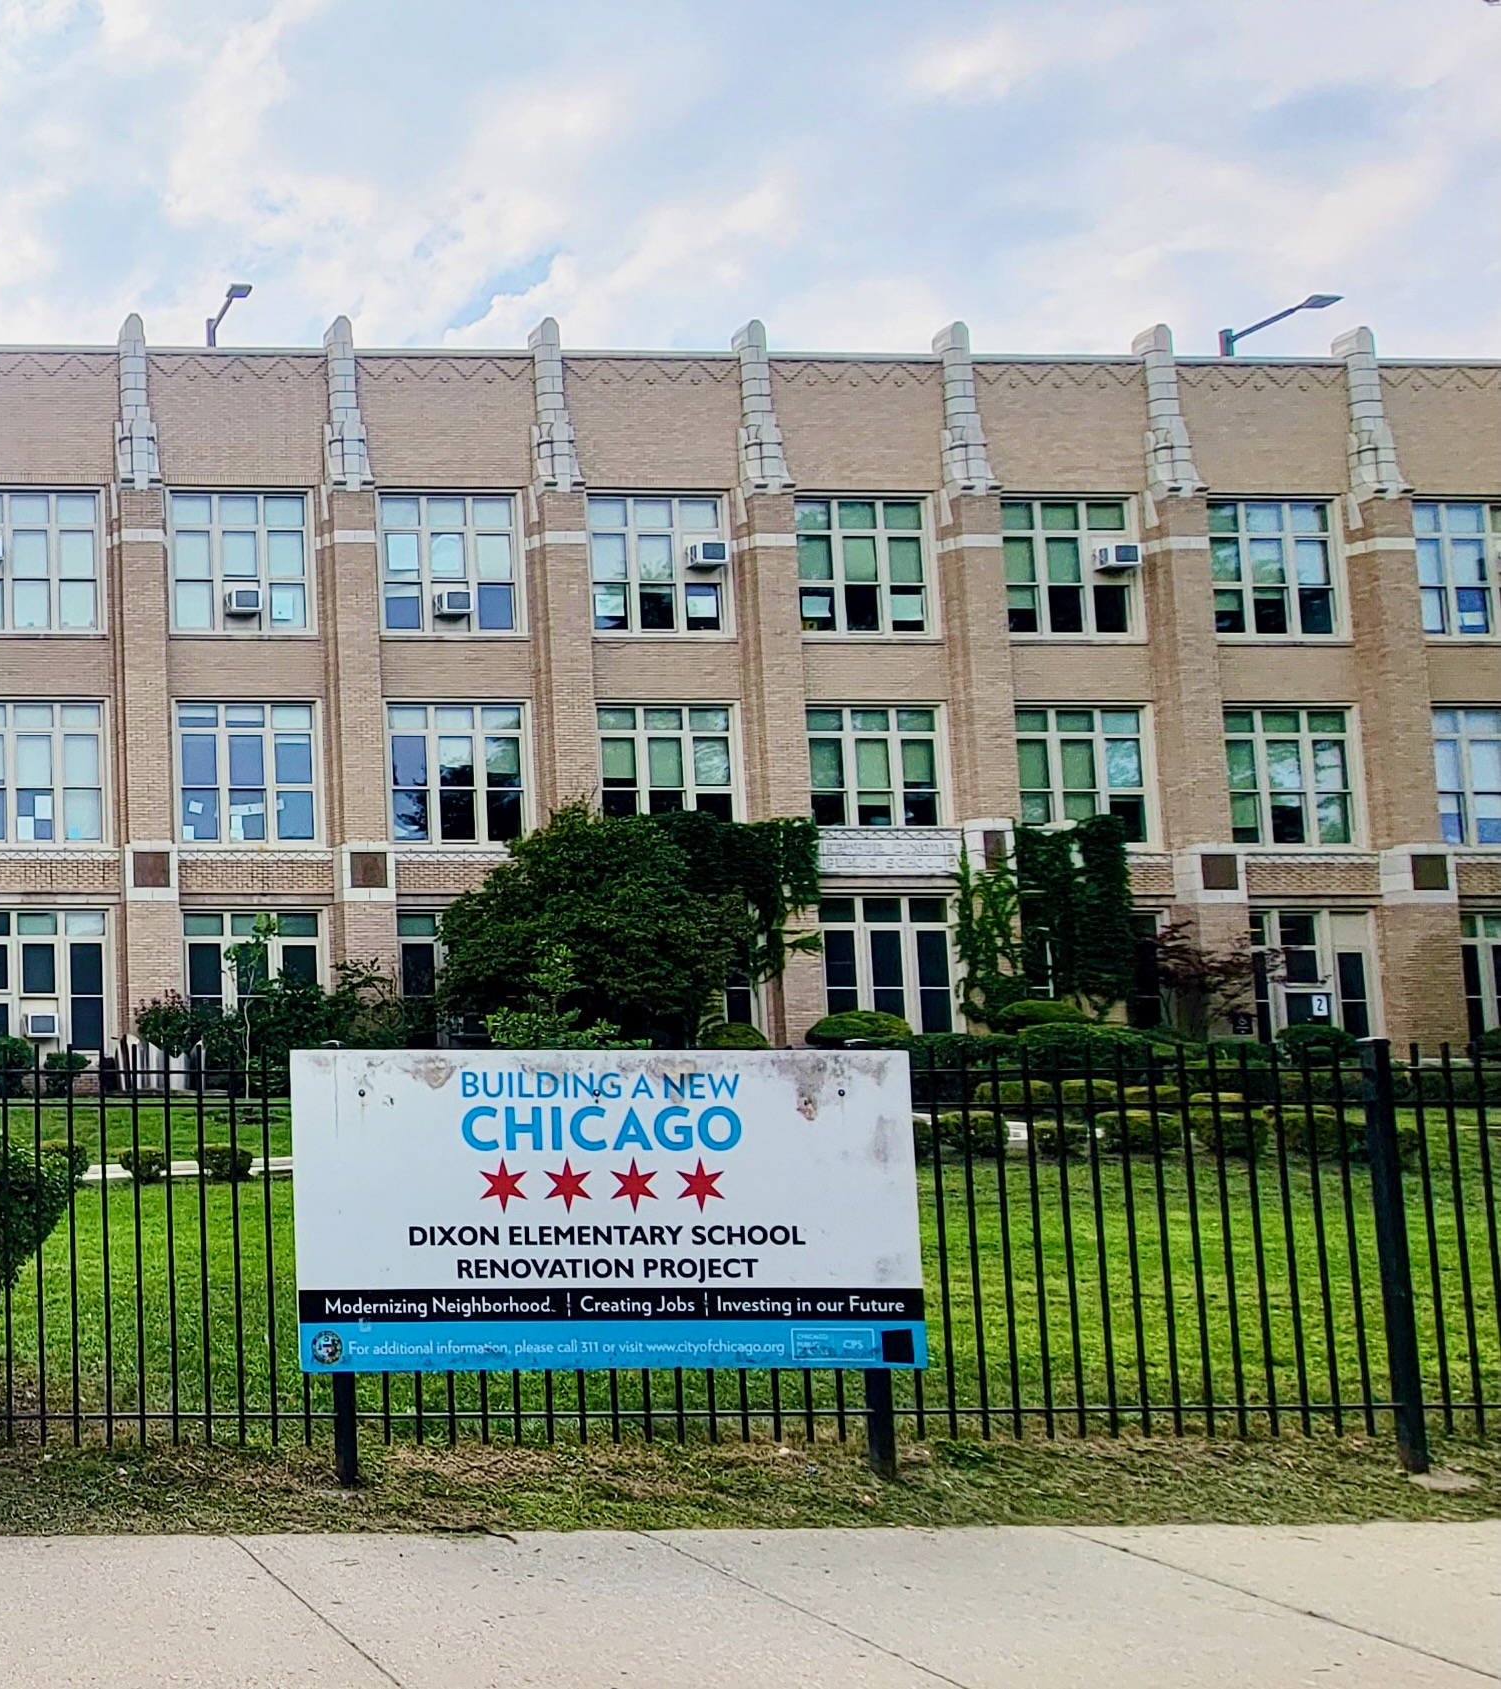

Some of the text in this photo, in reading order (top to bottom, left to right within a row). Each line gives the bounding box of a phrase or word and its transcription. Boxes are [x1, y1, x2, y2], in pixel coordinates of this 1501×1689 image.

[1316, 998, 1324, 1011] 2
[461, 1071, 740, 1099] BUILDING A NEW
[461, 1105, 742, 1152] CHICAGO
[409, 1225, 806, 1247] DIXON ELEMENTARY SCHOOL
[456, 1258, 759, 1283] RENOVATION PROJECT
[325, 1297, 427, 1317] Modernizing
[580, 1295, 695, 1315] Creating Jobs
[717, 1296, 905, 1316] Investing in our Future
[348, 1341, 369, 1355] For
[372, 1341, 433, 1355] additional
[436, 1341, 511, 1356] information,
[514, 1340, 553, 1356] please
[557, 1339, 578, 1353] call
[581, 1341, 599, 1353] 311
[603, 1344, 615, 1353] or
[619, 1341, 643, 1353] visit
[646, 1338, 785, 1356] www.cityofchicago.org
